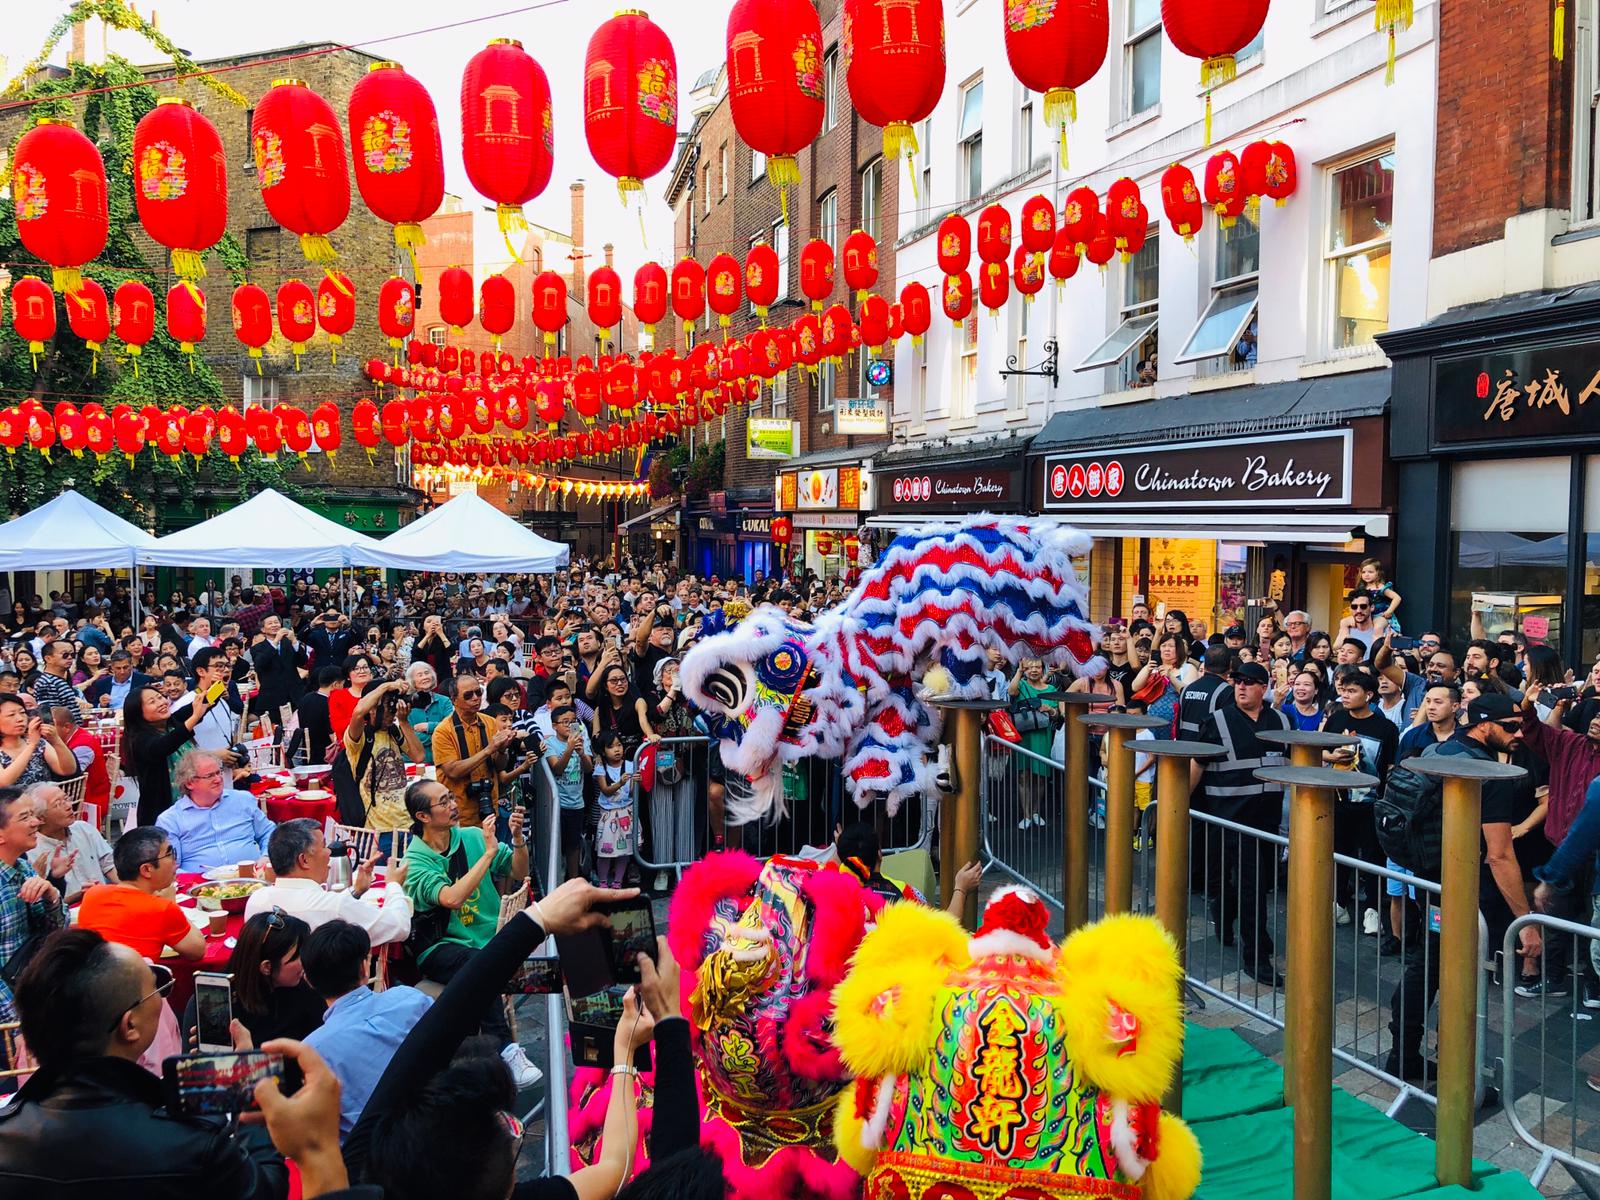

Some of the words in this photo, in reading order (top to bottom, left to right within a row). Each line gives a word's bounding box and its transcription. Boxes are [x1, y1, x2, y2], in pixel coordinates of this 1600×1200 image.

[935, 479, 972, 495] Chinatown
[973, 476, 1004, 497] Bakery
[1052, 464, 1122, 494] 唐人餅家
[1134, 463, 1236, 491] Chinatown
[1241, 455, 1332, 497] Bakery
[1184, 690, 1208, 701] SECURITY
